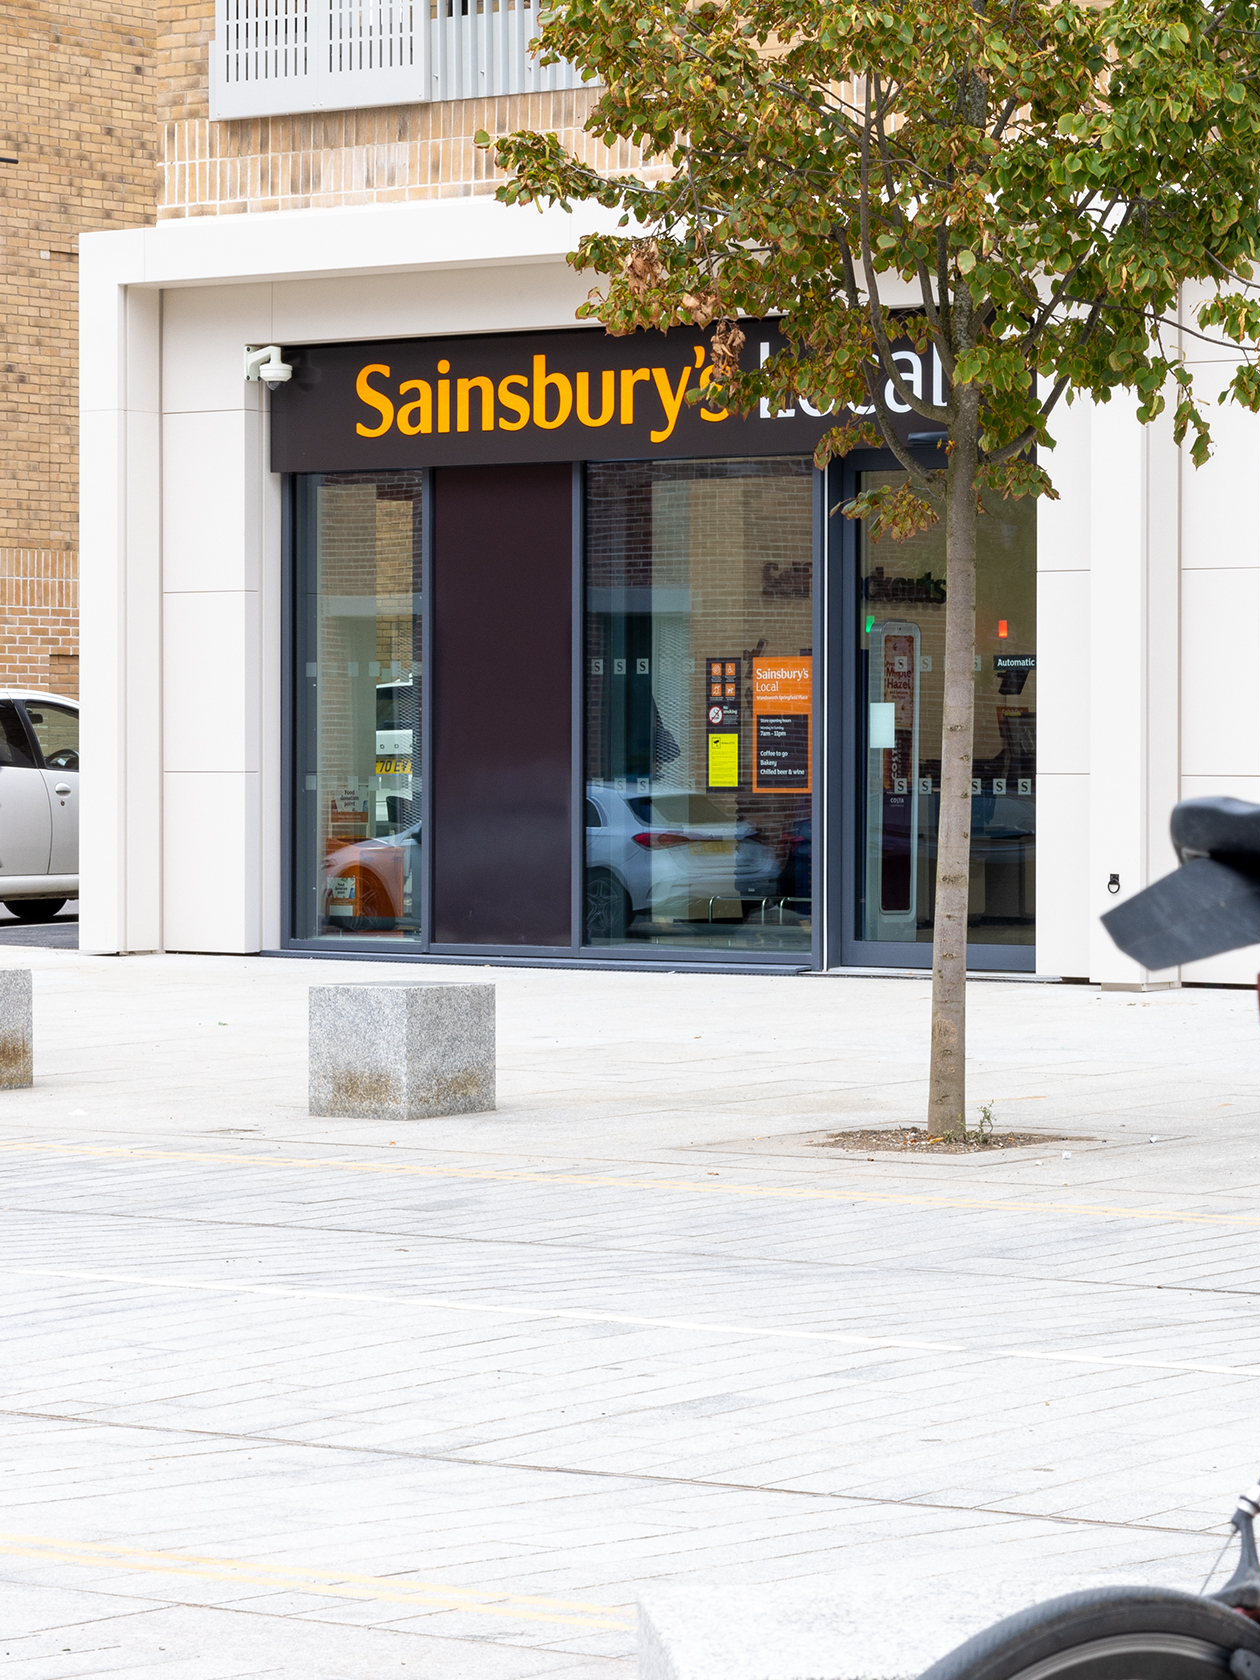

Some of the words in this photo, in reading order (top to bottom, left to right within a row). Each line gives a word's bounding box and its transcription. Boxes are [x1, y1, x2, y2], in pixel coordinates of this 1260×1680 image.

[355, 345, 732, 444] Sainsbury's
[997, 658, 1036, 667] Automatic
[756, 668, 809, 681] Sainsbury's
[886, 667, 912, 680] Mple
[755, 681, 779, 692] Local
[886, 678, 911, 690] Hazel
[393, 760, 412, 773] EV
